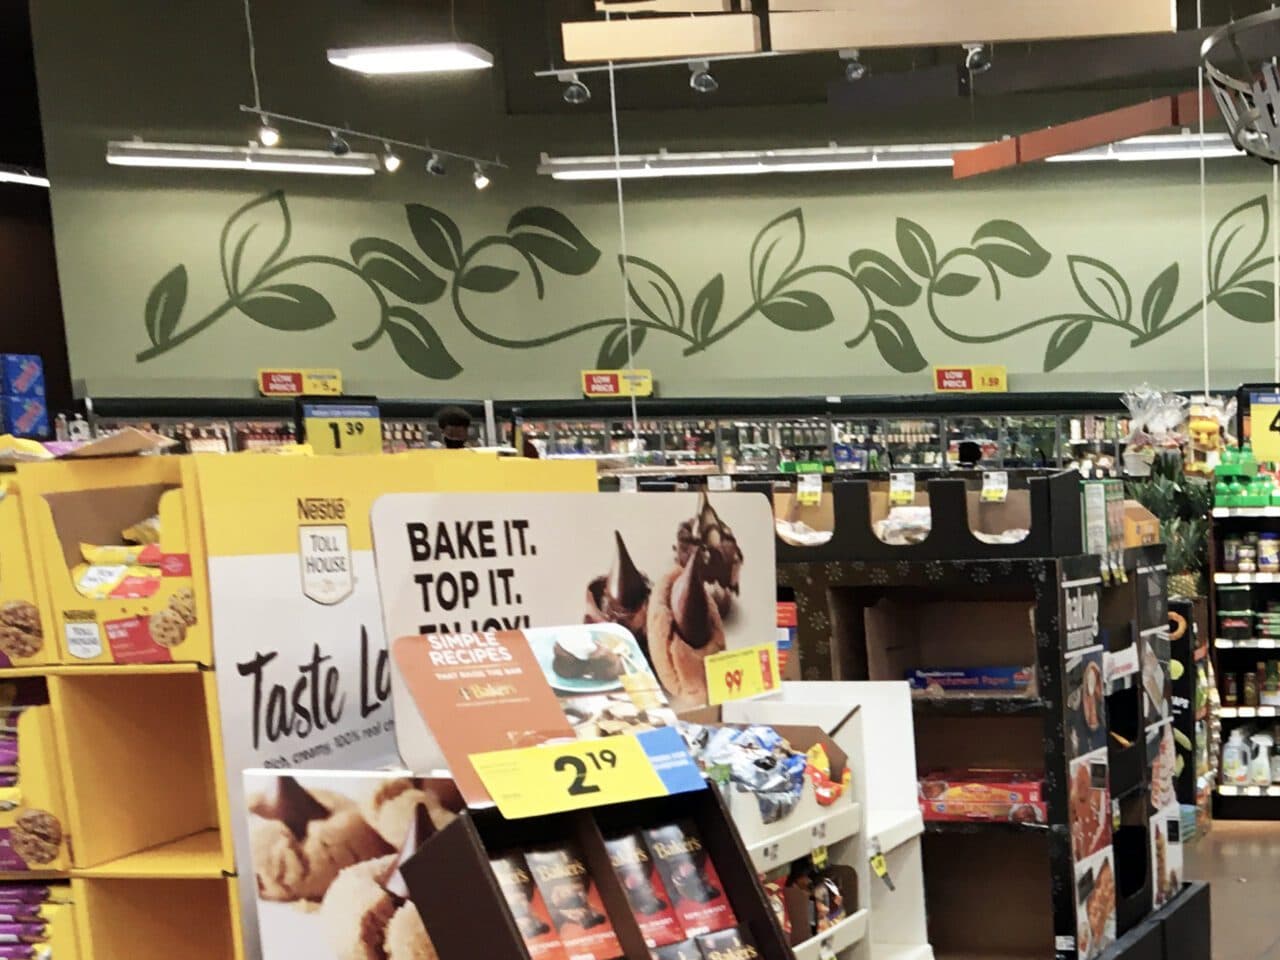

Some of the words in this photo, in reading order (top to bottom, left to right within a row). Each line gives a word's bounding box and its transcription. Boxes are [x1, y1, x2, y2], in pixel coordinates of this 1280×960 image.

[328, 422, 341, 449] 1
[346, 422, 364, 435] 39
[310, 534, 340, 552] TOLL
[406, 520, 497, 562] BAKE
[504, 519, 537, 557] IT.
[306, 556, 346, 574] HOUSE
[415, 572, 479, 612] TOP
[488, 568, 522, 606] IT.
[427, 627, 500, 650] SIMPLE
[429, 646, 513, 667] RECIPES
[236, 643, 346, 751] Taste
[554, 755, 601, 796] 2
[586, 749, 617, 770] 19
